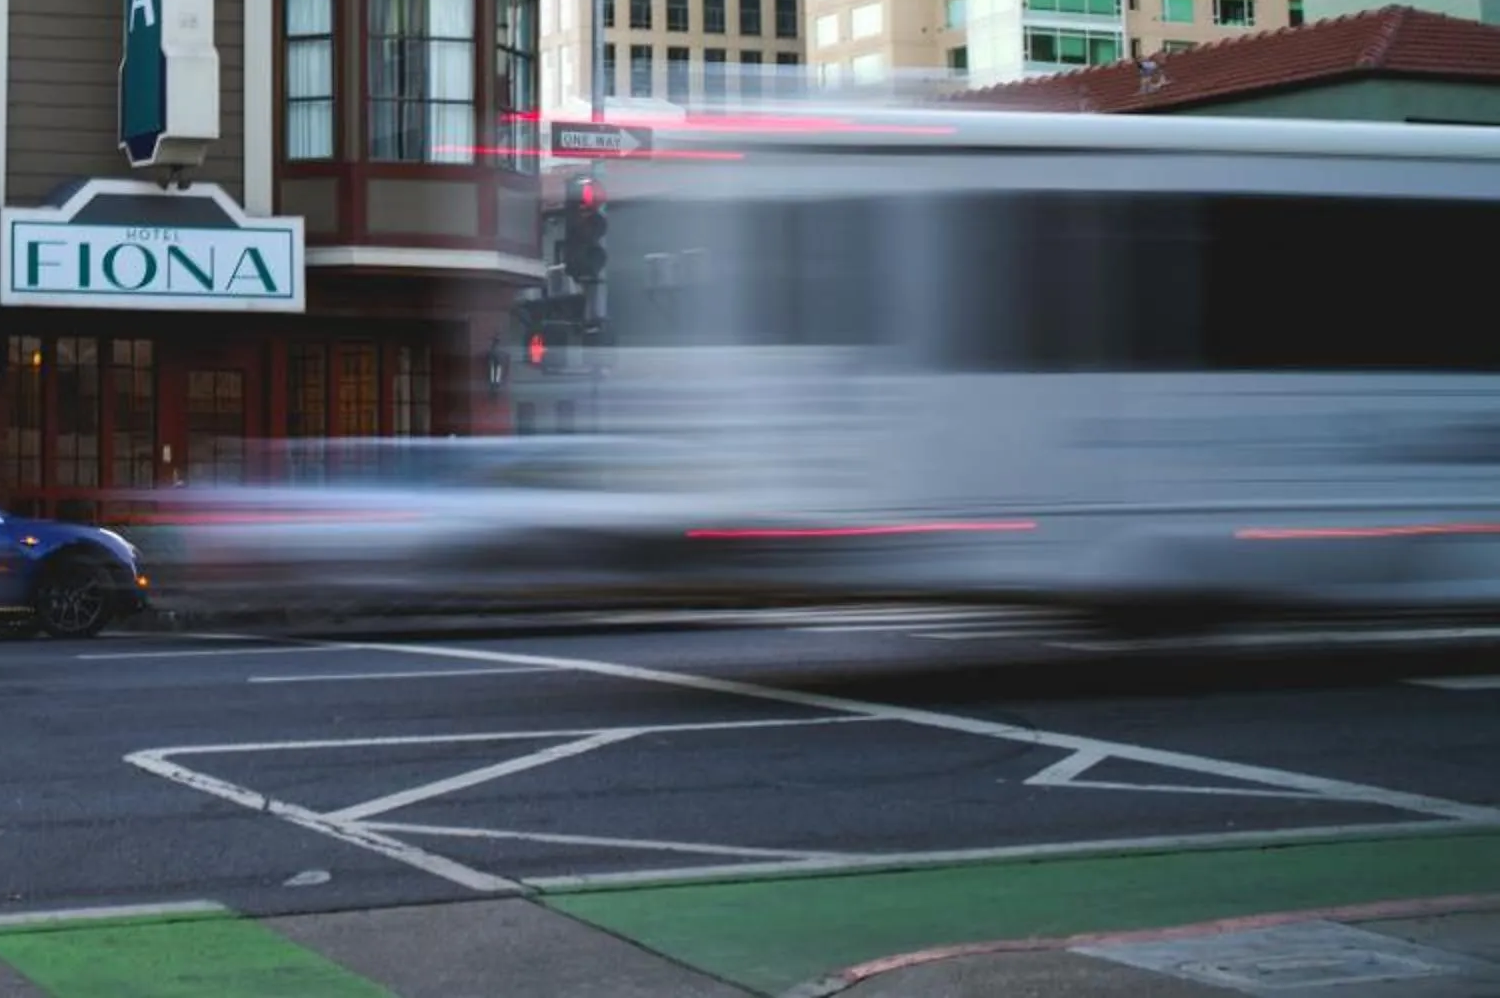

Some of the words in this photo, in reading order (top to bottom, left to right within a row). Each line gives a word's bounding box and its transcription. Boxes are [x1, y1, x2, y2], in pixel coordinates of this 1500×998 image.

[562, 133, 591, 147] ONE
[594, 135, 621, 149] WAY
[125, 227, 182, 243] HOTEL
[26, 240, 278, 293] FIONA
